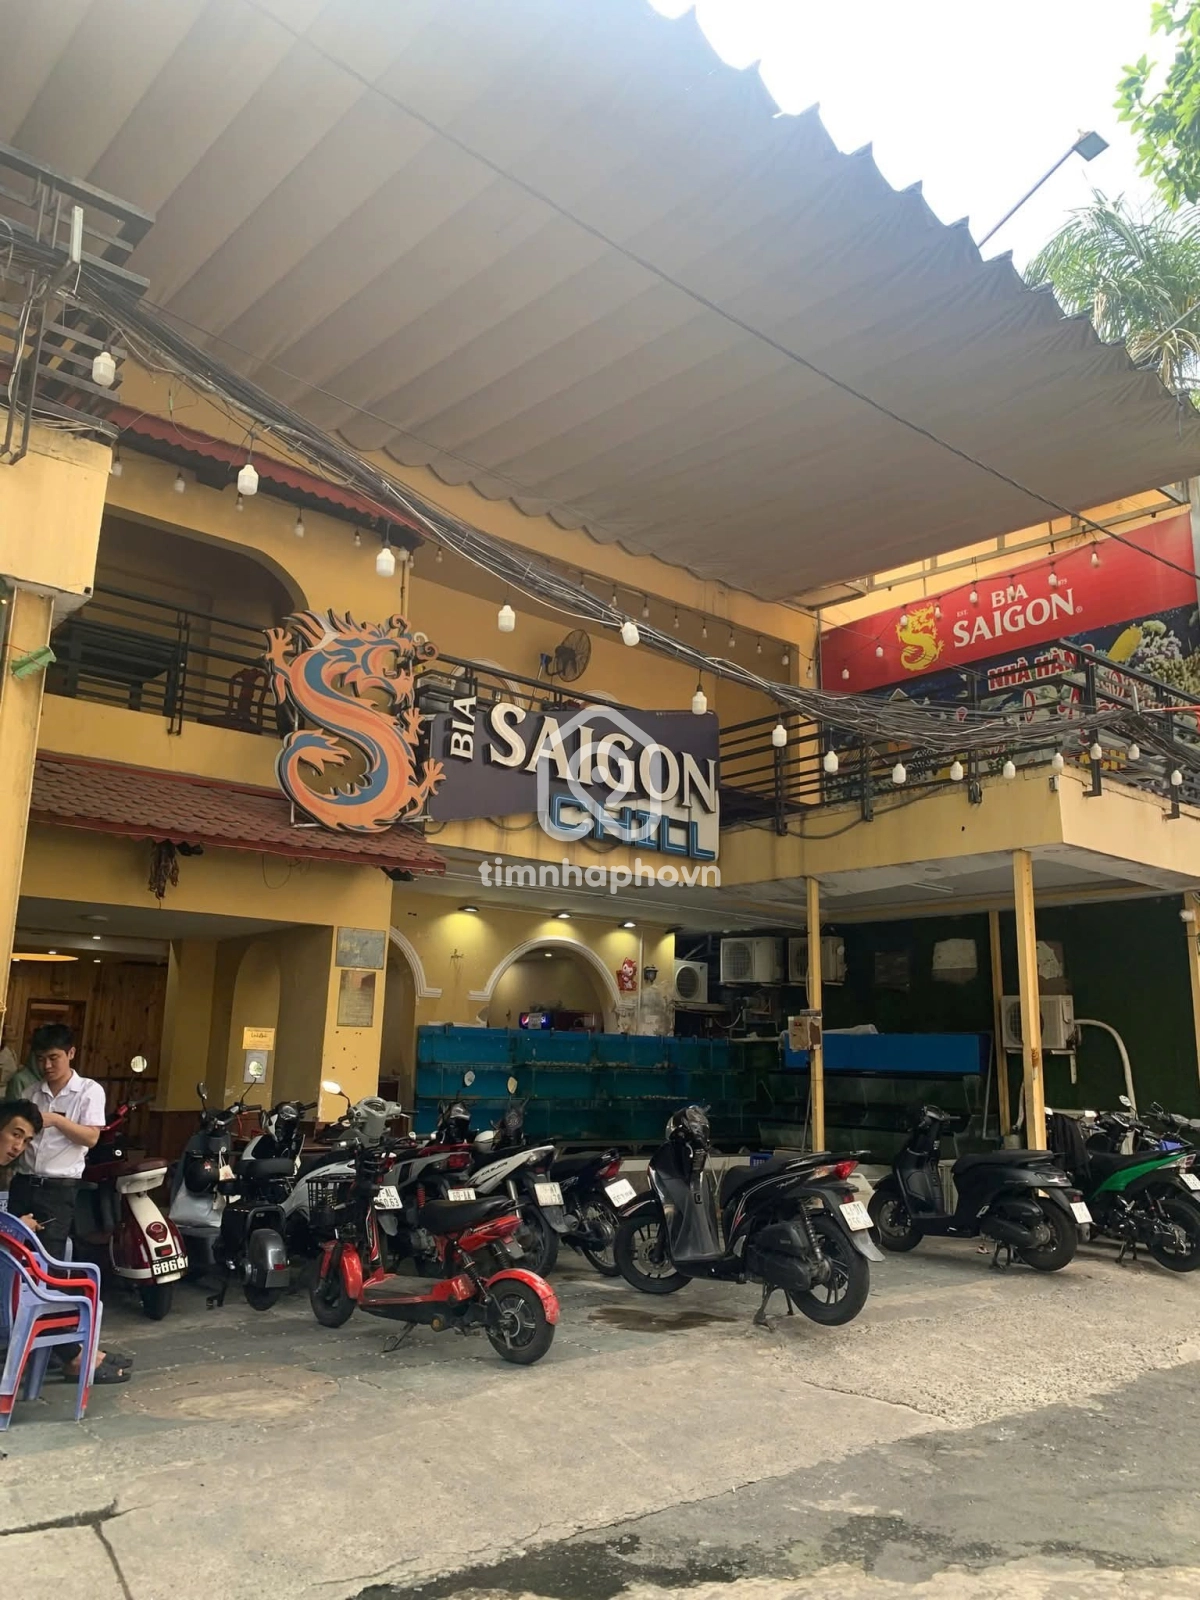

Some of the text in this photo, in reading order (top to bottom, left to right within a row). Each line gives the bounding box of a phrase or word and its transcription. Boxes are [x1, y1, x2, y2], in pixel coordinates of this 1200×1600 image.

[953, 588, 1075, 648] SAIGON
[991, 583, 1029, 609] BIA
[987, 656, 1032, 691] NHÀ
[450, 696, 477, 761] BIA
[489, 702, 717, 814] SAIGON
[550, 793, 716, 862] CHILL
